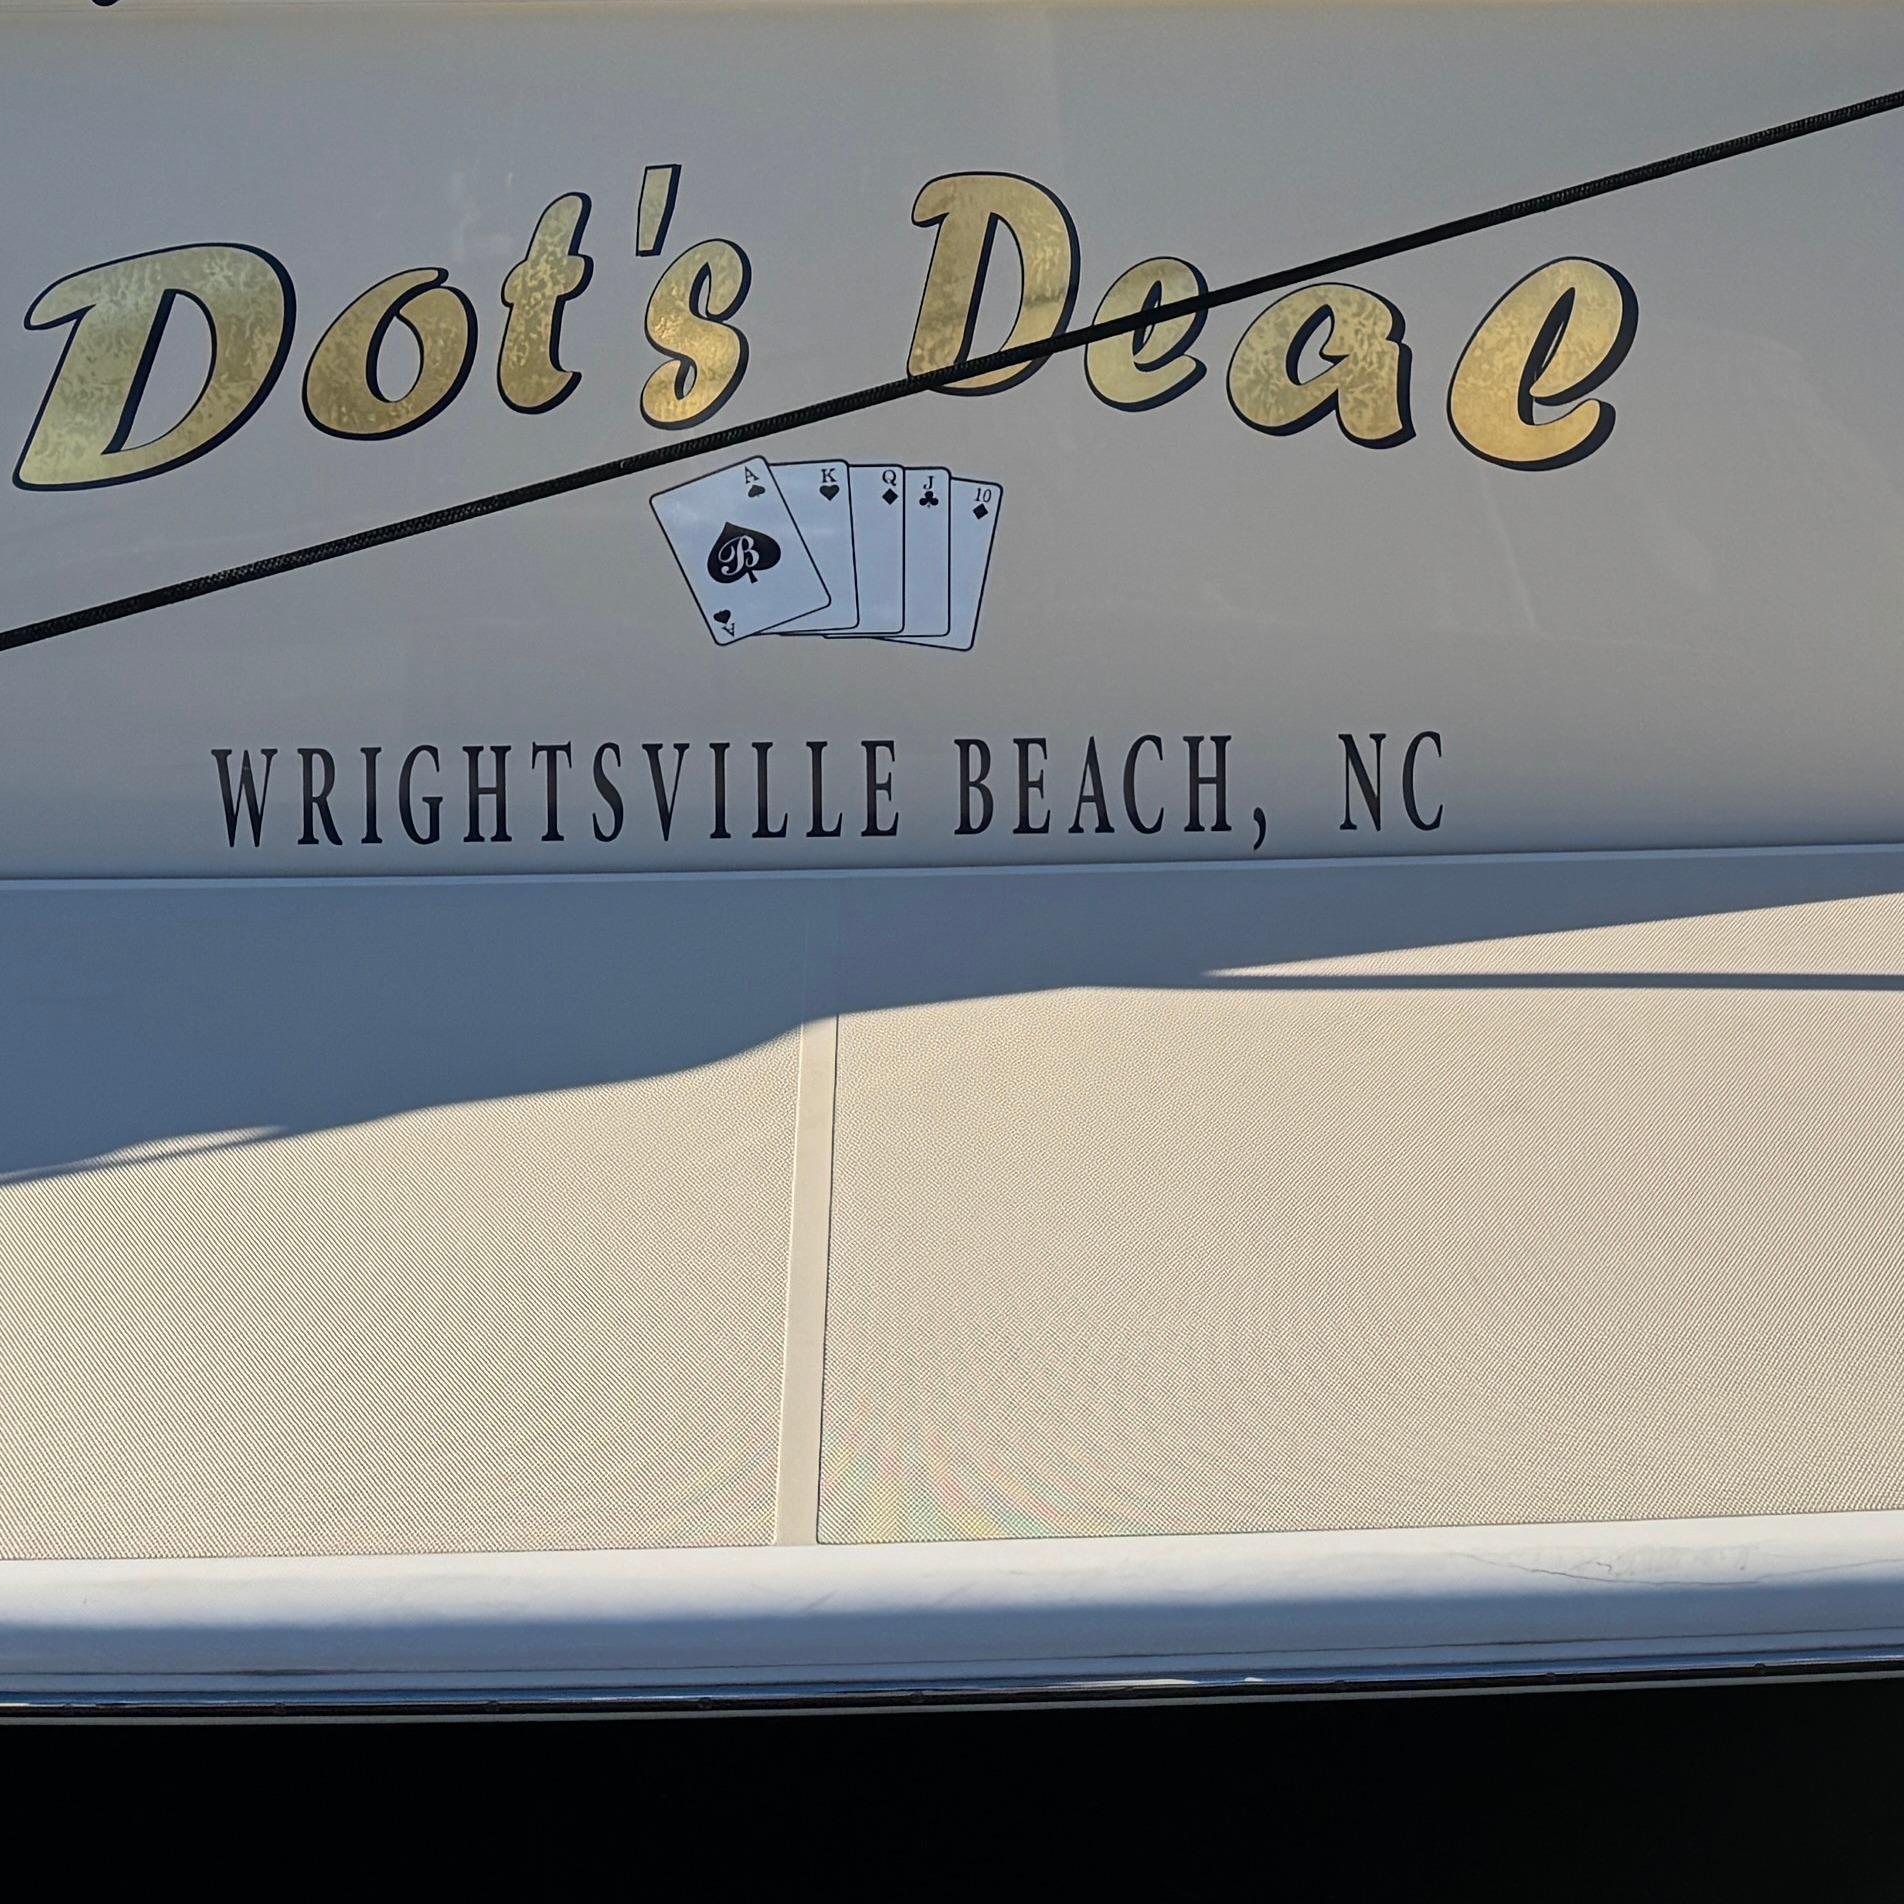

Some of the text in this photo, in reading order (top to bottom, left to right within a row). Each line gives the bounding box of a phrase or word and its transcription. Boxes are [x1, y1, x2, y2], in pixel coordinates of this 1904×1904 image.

[12, 163, 752, 492] Dot's
[744, 466, 992, 504] A K Q J 10
[210, 730, 1444, 852] WRIGHTSVILLE BEACH, NC
